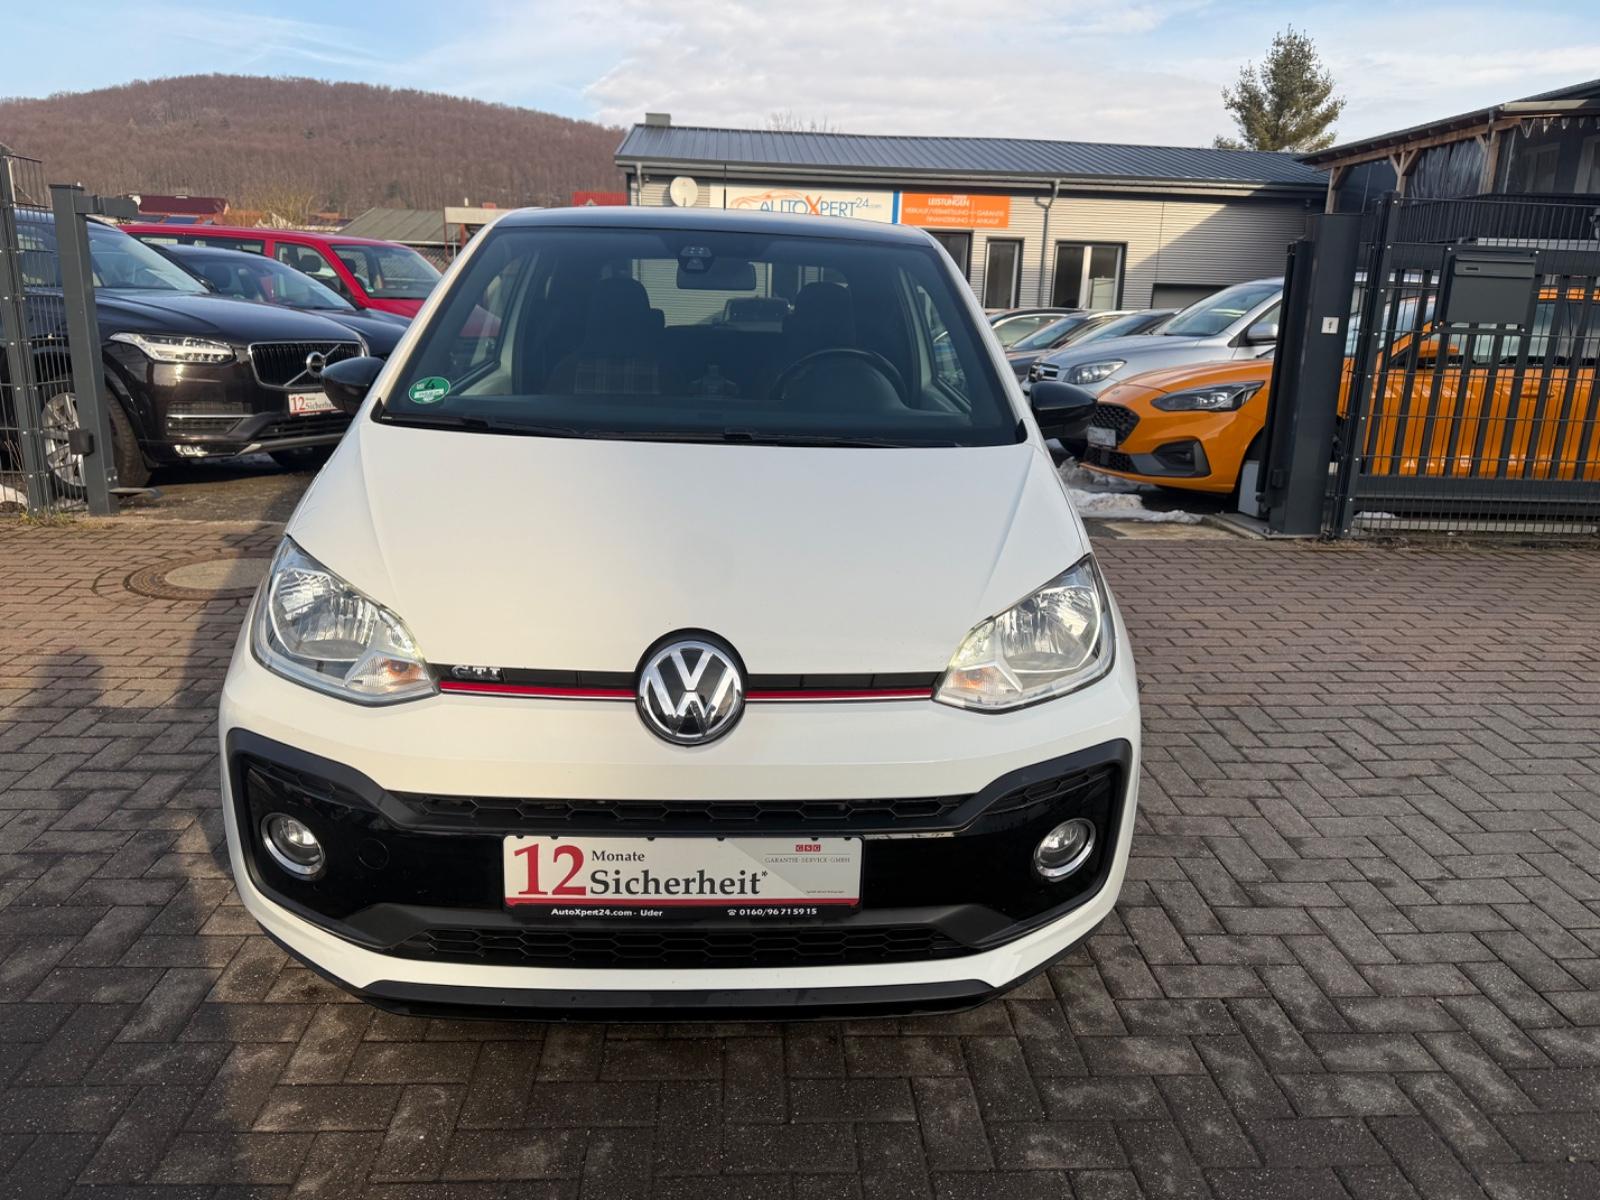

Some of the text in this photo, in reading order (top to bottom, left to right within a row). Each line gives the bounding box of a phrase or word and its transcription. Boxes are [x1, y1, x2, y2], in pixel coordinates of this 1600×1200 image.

[291, 396, 305, 411] 12
[451, 665, 501, 679] GTI
[592, 850, 645, 862] Monate
[514, 844, 587, 896] 12
[551, 908, 633, 917] AutoXpert24.com
[640, 909, 664, 917] Uder
